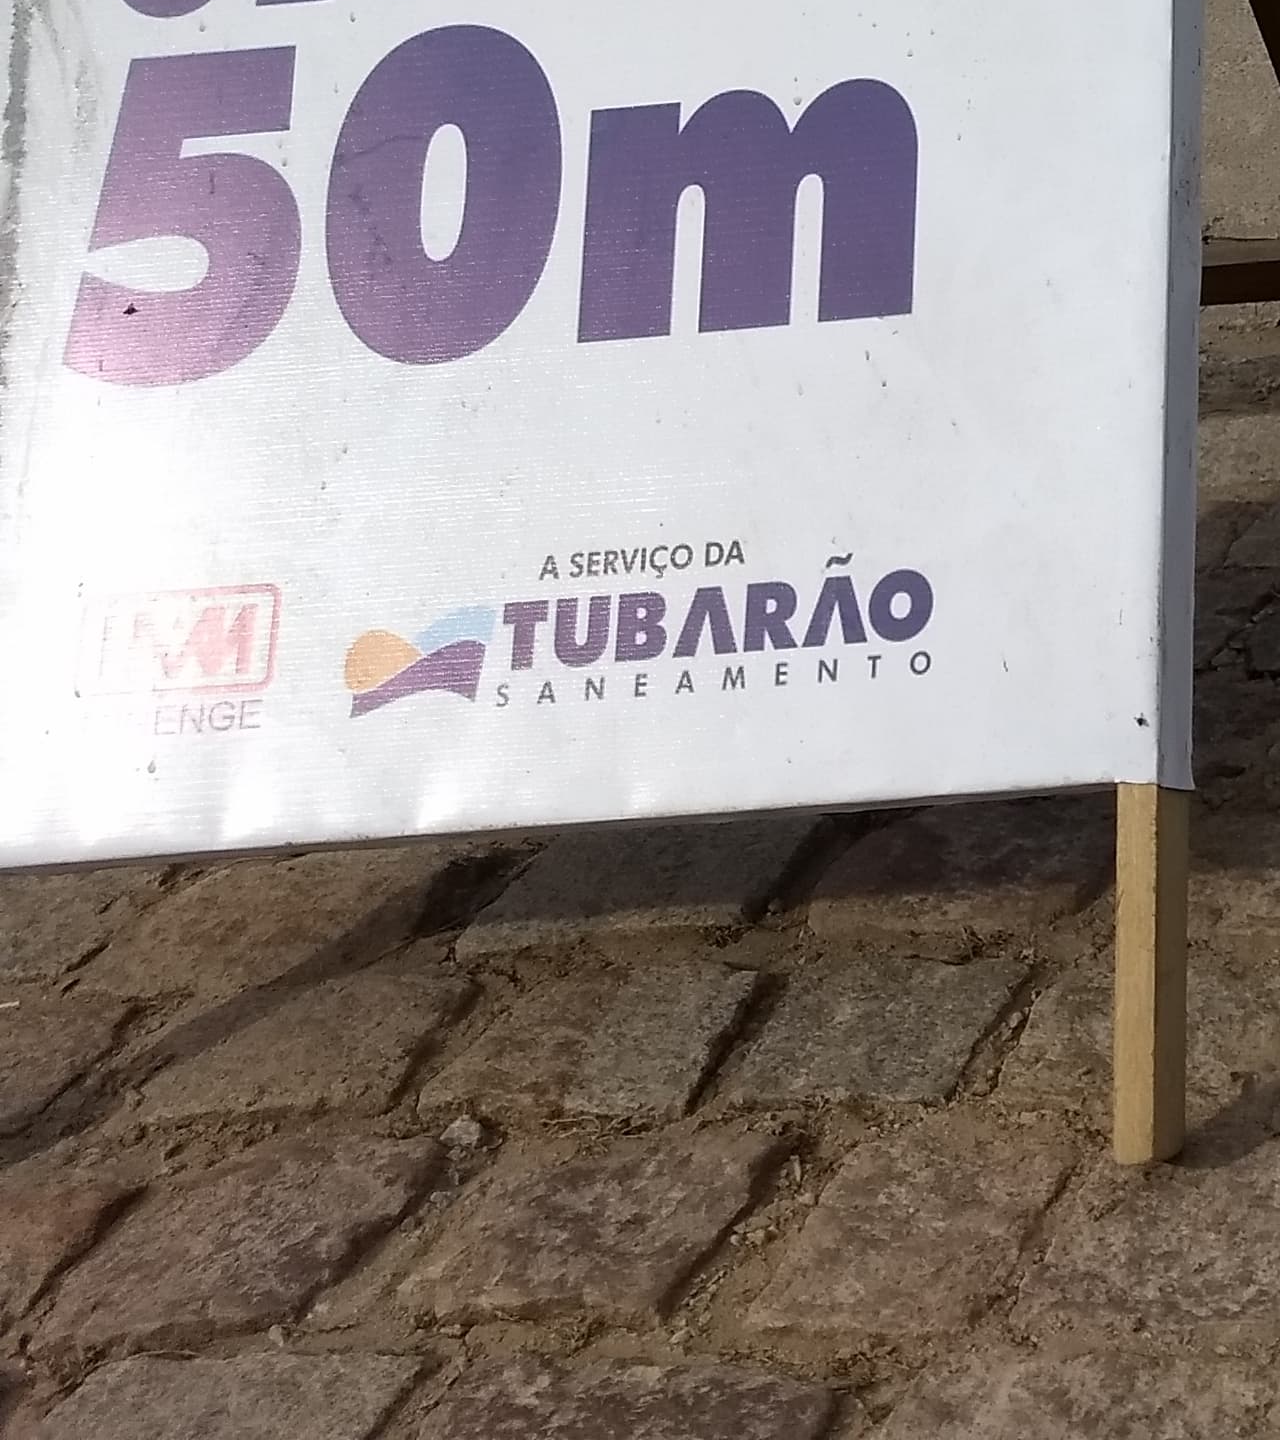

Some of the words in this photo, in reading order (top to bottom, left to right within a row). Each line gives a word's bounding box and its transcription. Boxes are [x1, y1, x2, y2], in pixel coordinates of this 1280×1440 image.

[63, 23, 920, 388] 50m
[539, 555, 560, 581] A
[569, 543, 694, 579] SERVIÇO
[705, 540, 745, 568] DA
[503, 552, 934, 671] TUBARÃO
[496, 650, 932, 708] SANEAMENTO
